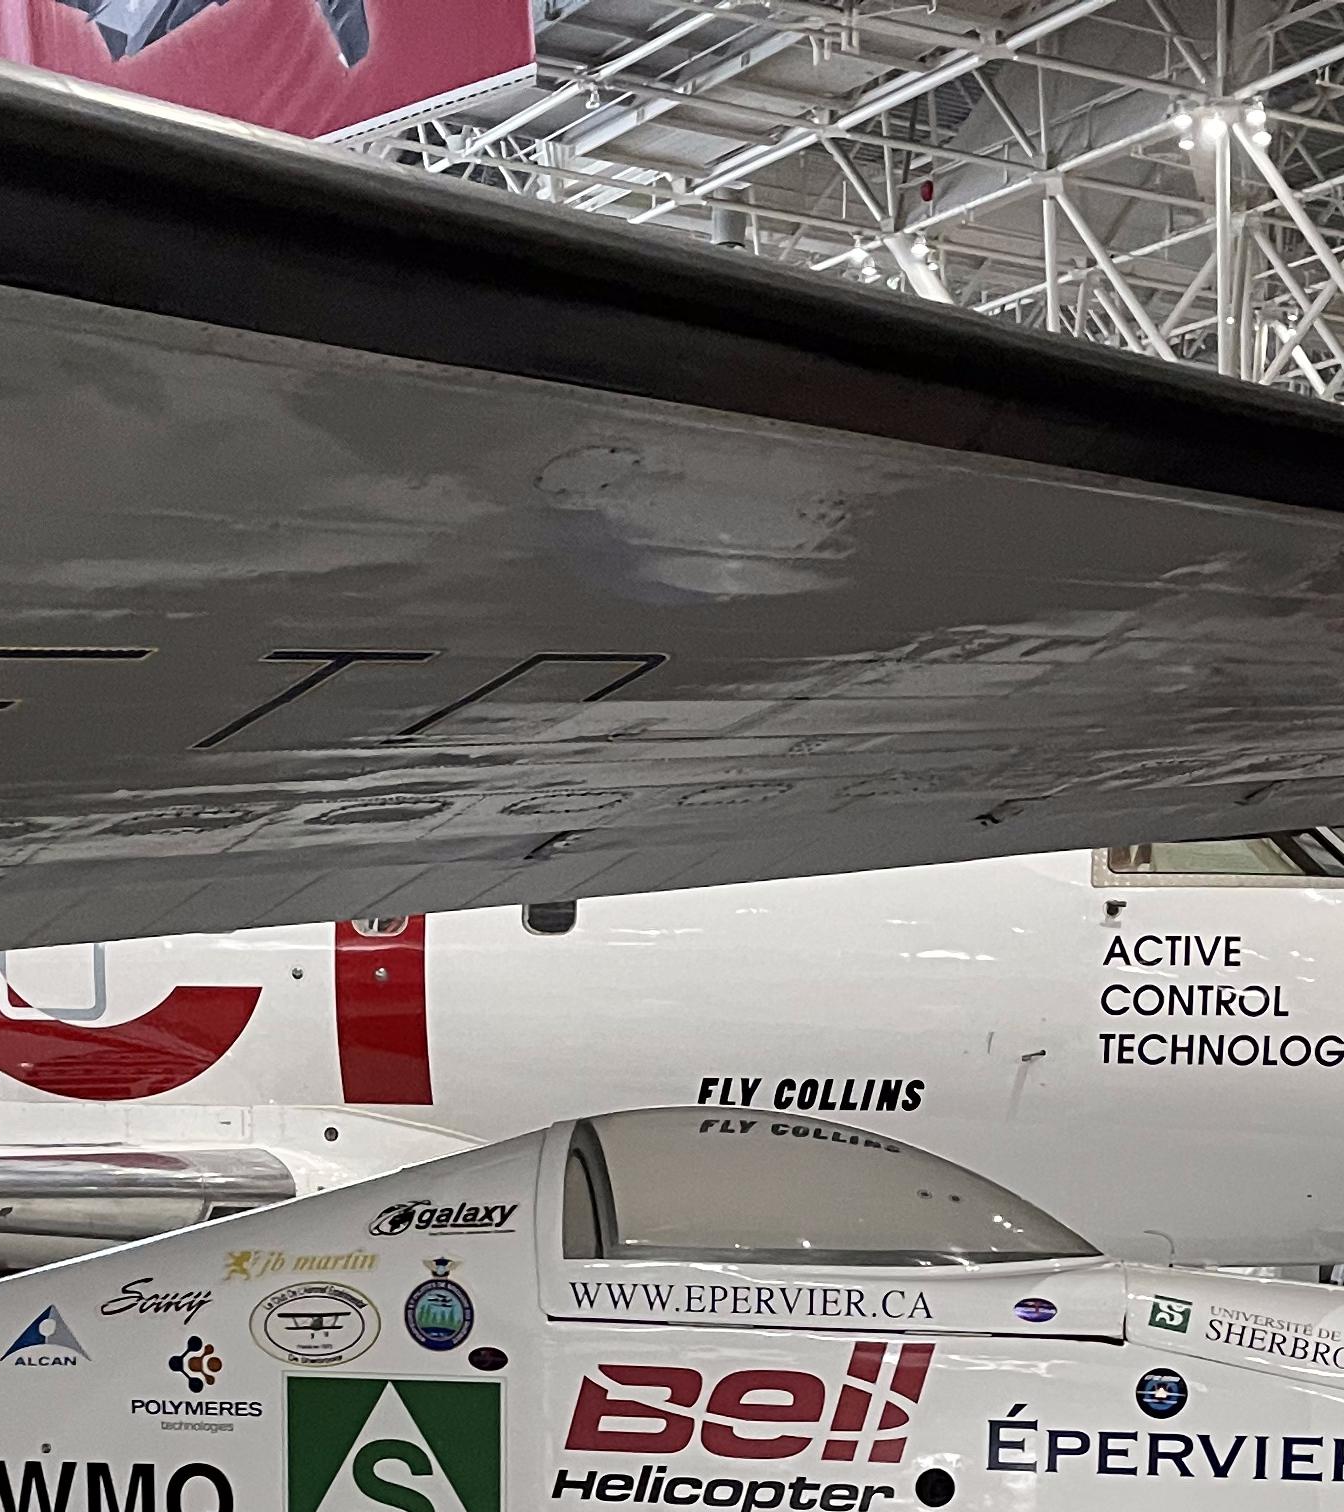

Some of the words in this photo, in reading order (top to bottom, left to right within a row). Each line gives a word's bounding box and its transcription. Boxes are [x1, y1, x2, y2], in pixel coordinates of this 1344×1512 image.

[1103, 935, 1241, 966] ACTIVE
[1101, 984, 1289, 1017] CONTROL
[697, 1077, 762, 1106] FLY
[773, 1078, 925, 1111] COLLINS
[415, 1202, 519, 1229] galaxy
[292, 1249, 379, 1272] martin
[569, 1281, 933, 1319] WWW.EPERVIER.CA
[1210, 1305, 1314, 1336] UNIVERSITÉ
[1318, 1327, 1342, 1342] DE
[15, 1356, 77, 1366] ALCAN
[131, 1399, 263, 1417] POLYMERES
[564, 1341, 936, 1463] Bell
